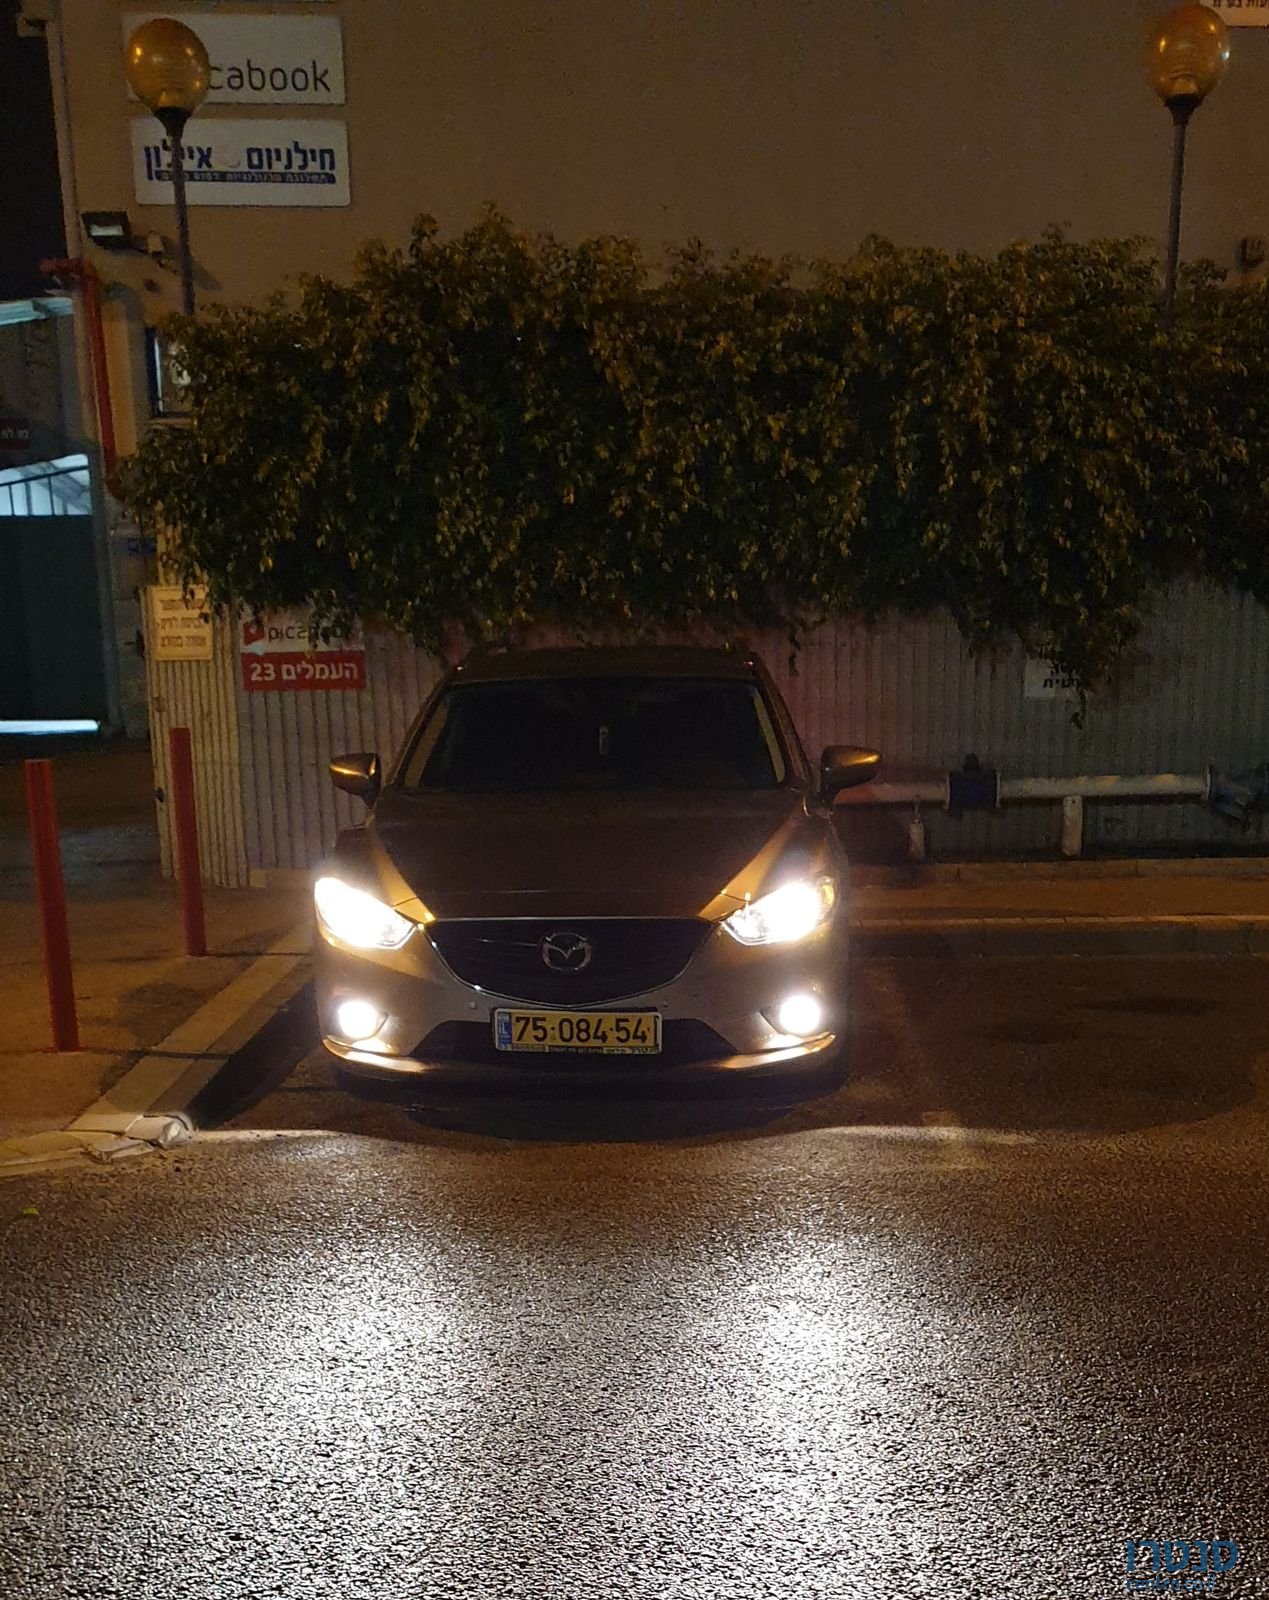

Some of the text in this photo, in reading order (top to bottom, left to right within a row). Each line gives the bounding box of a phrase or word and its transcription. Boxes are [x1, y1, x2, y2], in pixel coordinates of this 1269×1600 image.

[208, 59, 331, 92] cabook
[250, 660, 359, 682] העמלים 23
